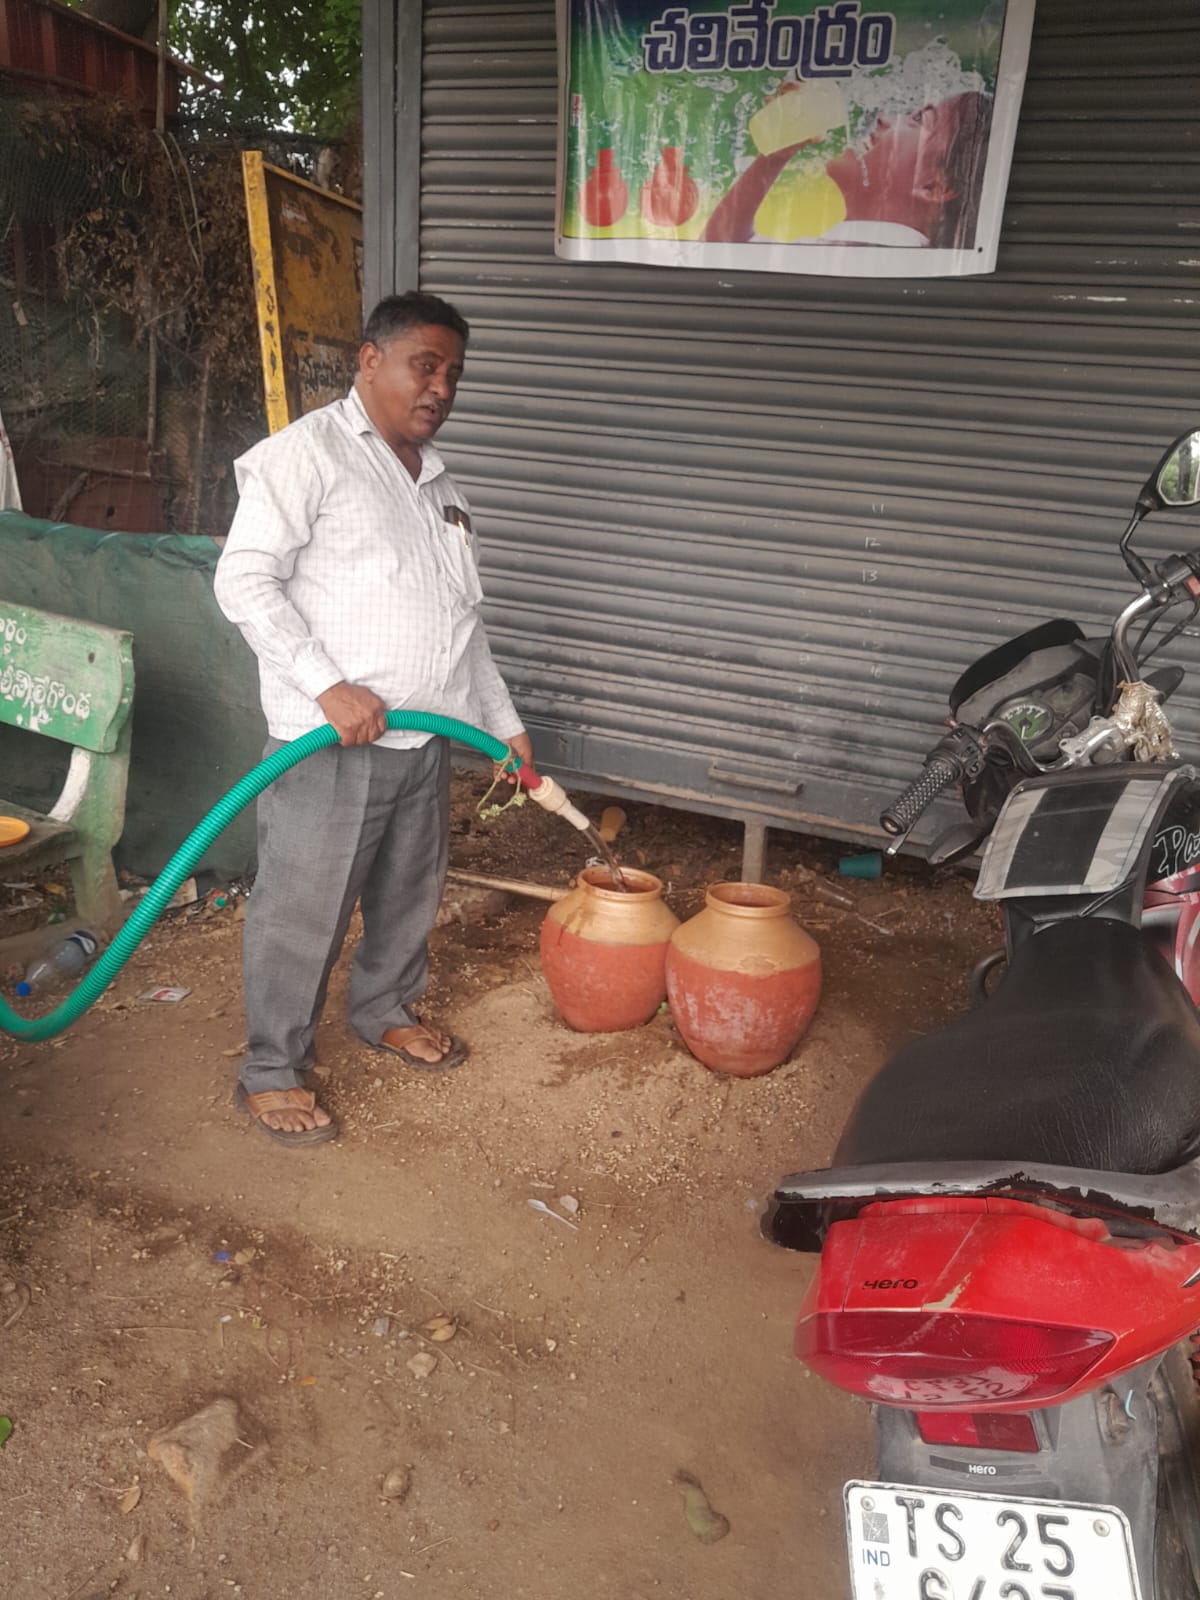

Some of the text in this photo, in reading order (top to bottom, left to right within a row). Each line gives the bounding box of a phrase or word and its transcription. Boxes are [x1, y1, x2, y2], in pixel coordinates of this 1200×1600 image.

[642, 0, 895, 79] చలివేంద్రం
[865, 536, 881, 549] 12
[862, 569, 879, 583] 13
[968, 1464, 997, 1476] Hero
[895, 1496, 1076, 1577] TS 25
[861, 1548, 891, 1567] IND
